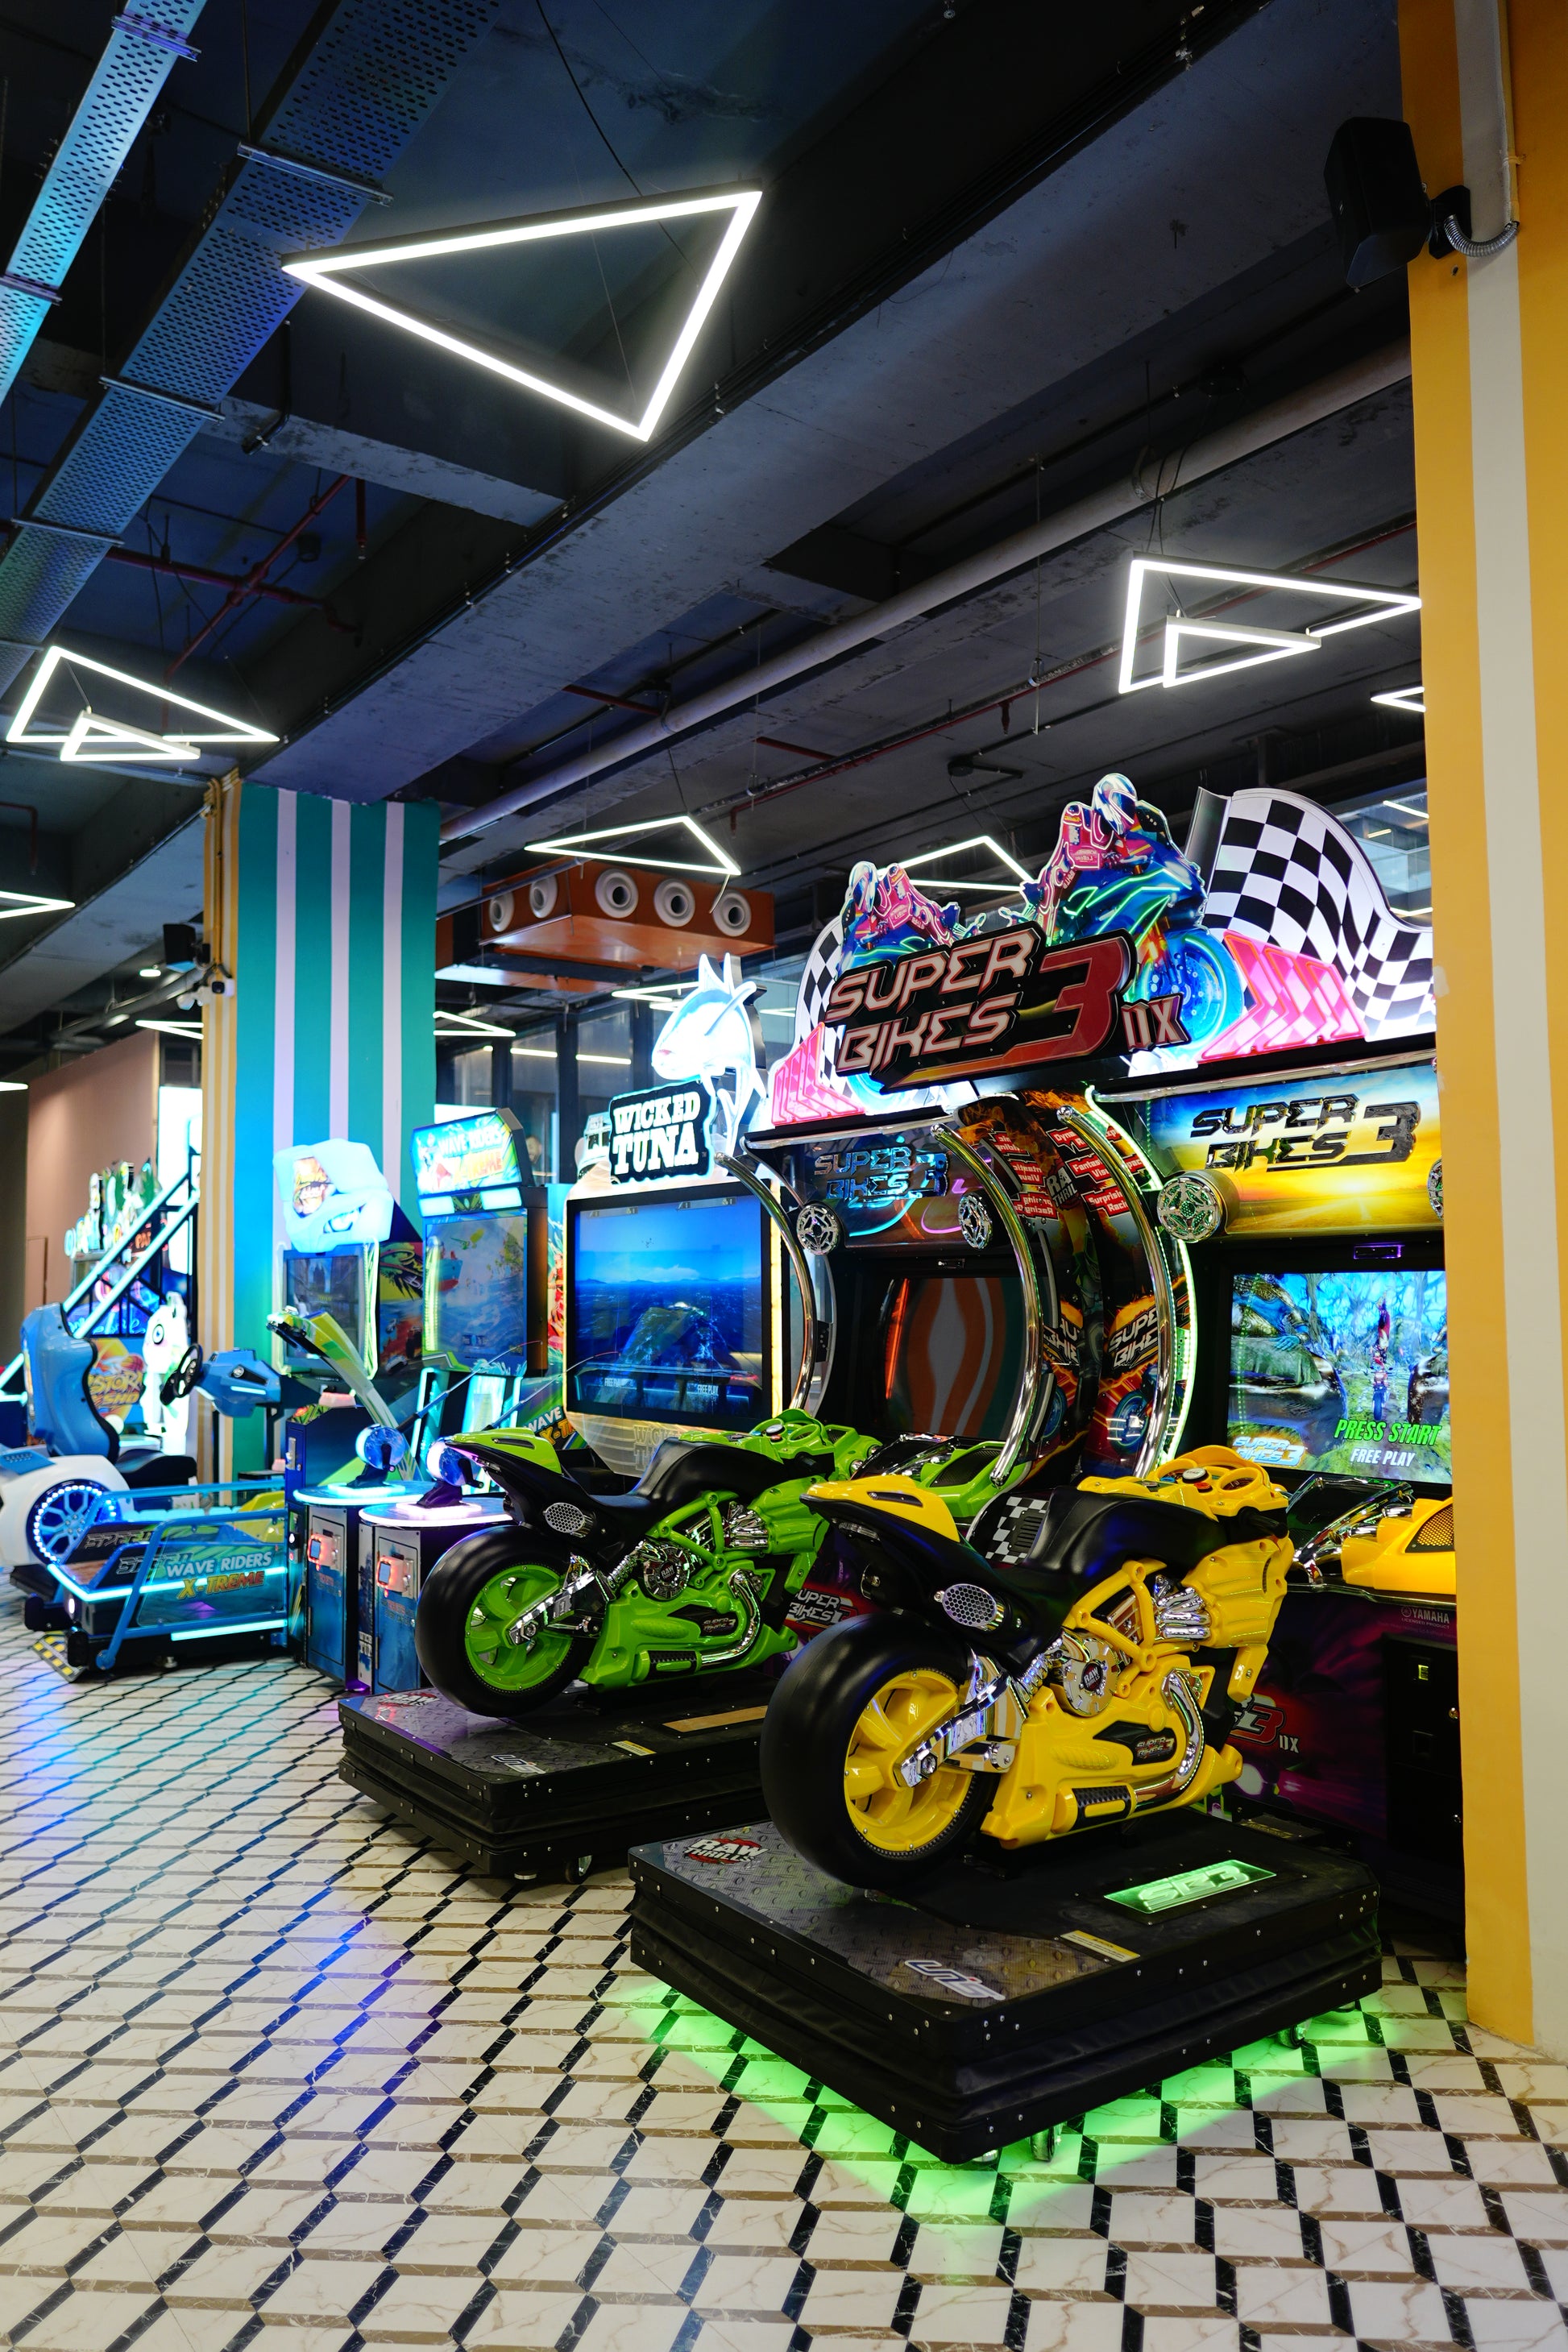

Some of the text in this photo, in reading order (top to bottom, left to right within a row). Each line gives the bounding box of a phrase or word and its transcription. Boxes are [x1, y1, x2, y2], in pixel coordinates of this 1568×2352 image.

[824, 930, 1036, 1022] SUPER
[836, 993, 1017, 1073] BIKES
[1036, 937, 1126, 1064] 3
[613, 1091, 701, 1135] WICKED
[1190, 1093, 1360, 1138] SUPER
[612, 1121, 699, 1176] TUNA
[1205, 1101, 1422, 1172] BIKES 3
[815, 1147, 912, 1176] SUPER
[826, 1153, 949, 1201] BIKES 3
[1047, 1167, 1072, 1197] RA
[1052, 1183, 1078, 1207] THRIL
[1109, 1307, 1158, 1353] SUPE
[1114, 1326, 1158, 1369] BIKE
[698, 1383, 719, 1395] FREE PLAY
[1233, 1436, 1291, 1450] SUPER
[1334, 1418, 1442, 1446] PRESS START
[1283, 1445, 1305, 1467] 3
[1350, 1447, 1416, 1467] FREE PLAY
[166, 1551, 274, 1578] WAVE RIDERS
[176, 1570, 265, 1600] X-TREME
[796, 1590, 840, 1609] UPER
[1402, 1617, 1450, 1629] LICENSED PRODUCT
[1412, 1607, 1450, 1624] YAMAHA
[1084, 1667, 1099, 1686] RAW
[683, 1847, 755, 1862] THRILLS
[691, 1839, 770, 1856] RAW
